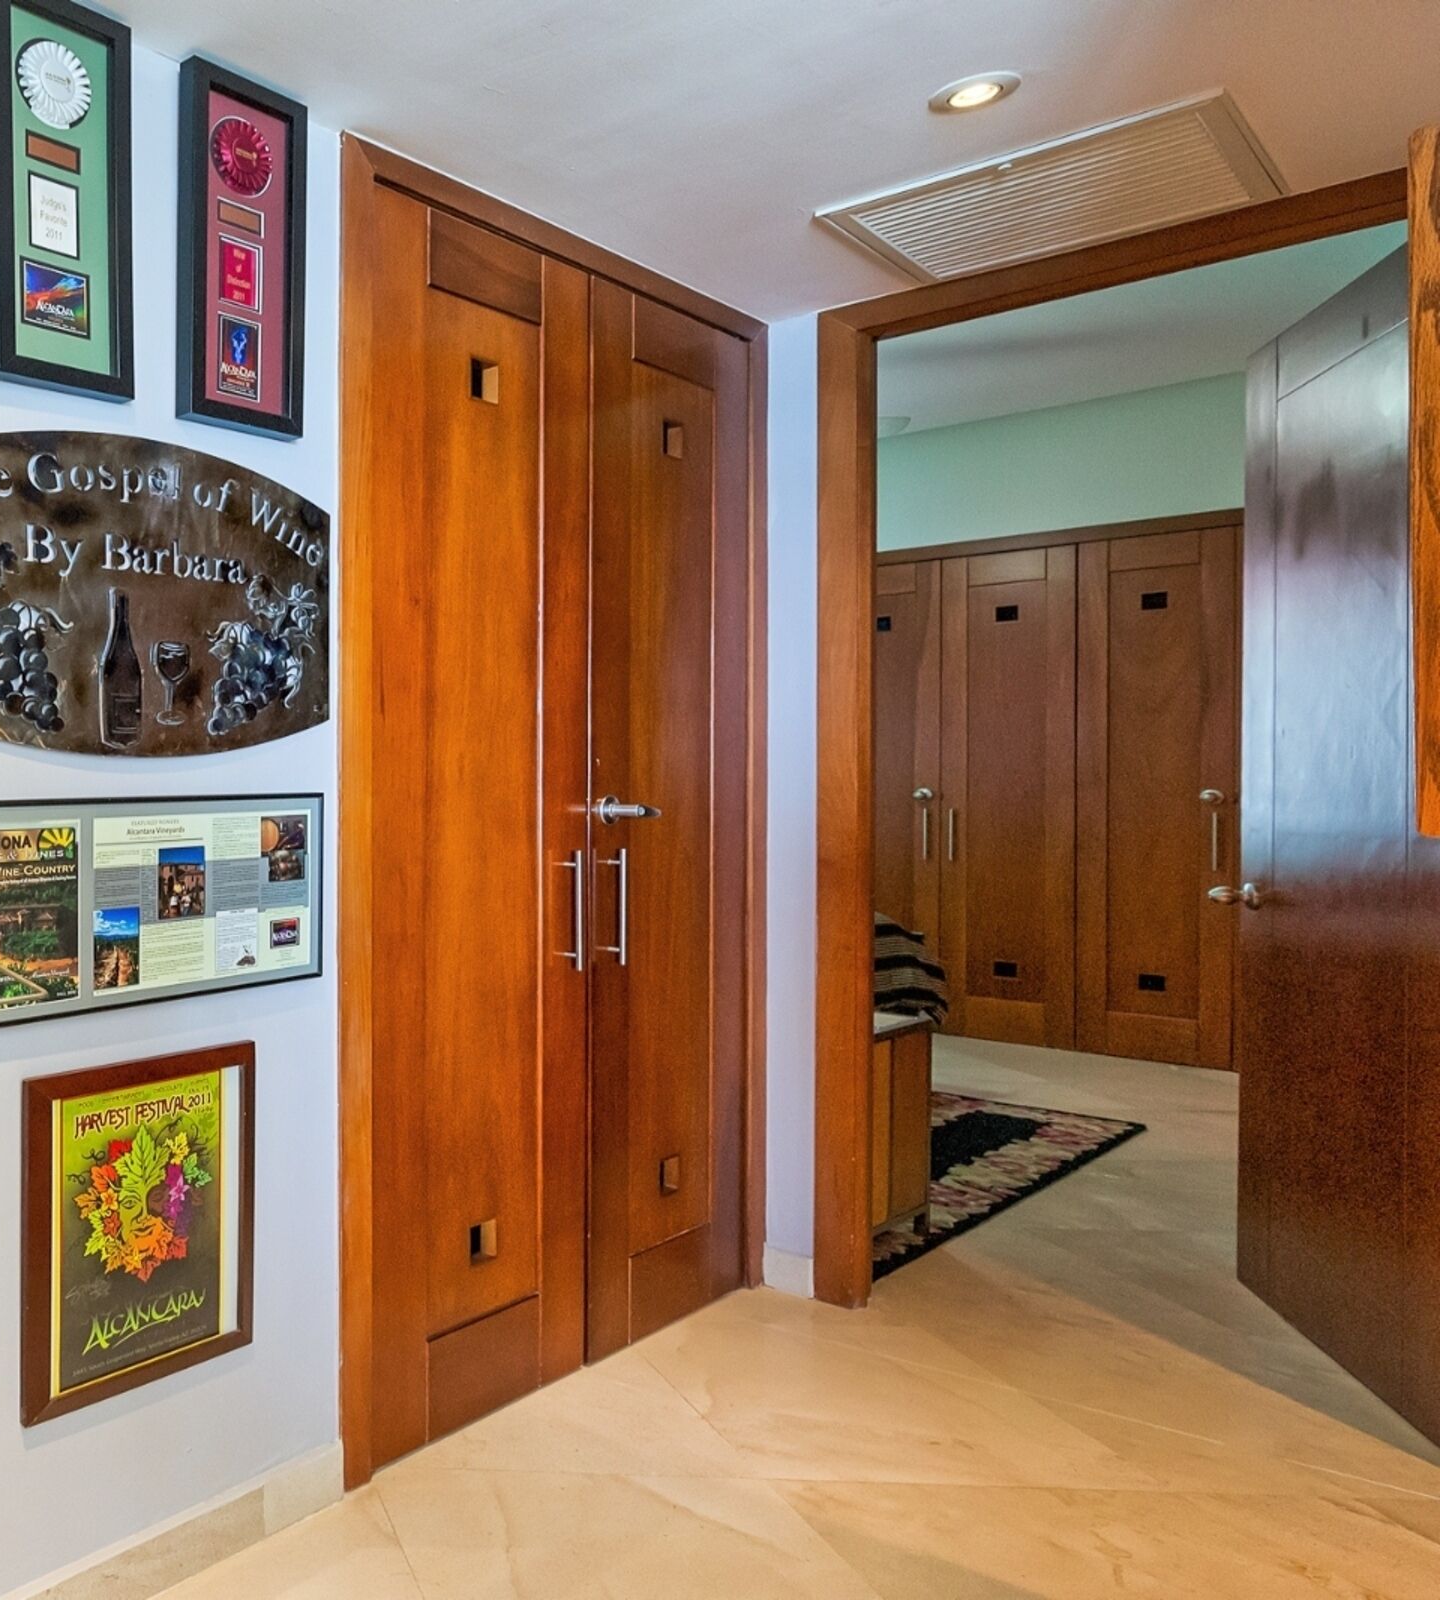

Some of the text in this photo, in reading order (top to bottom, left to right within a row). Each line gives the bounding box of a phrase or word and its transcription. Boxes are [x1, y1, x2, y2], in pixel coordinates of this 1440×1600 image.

[26, 452, 183, 504] Gospel
[192, 478, 241, 513] of
[249, 485, 324, 568] Wine
[23, 522, 249, 585] By Barbara
[155, 825, 186, 835] Vineyards
[23, 863, 77, 877] COUNTRY
[74, 1091, 213, 1140] HARVEST FESTIVAL 2011
